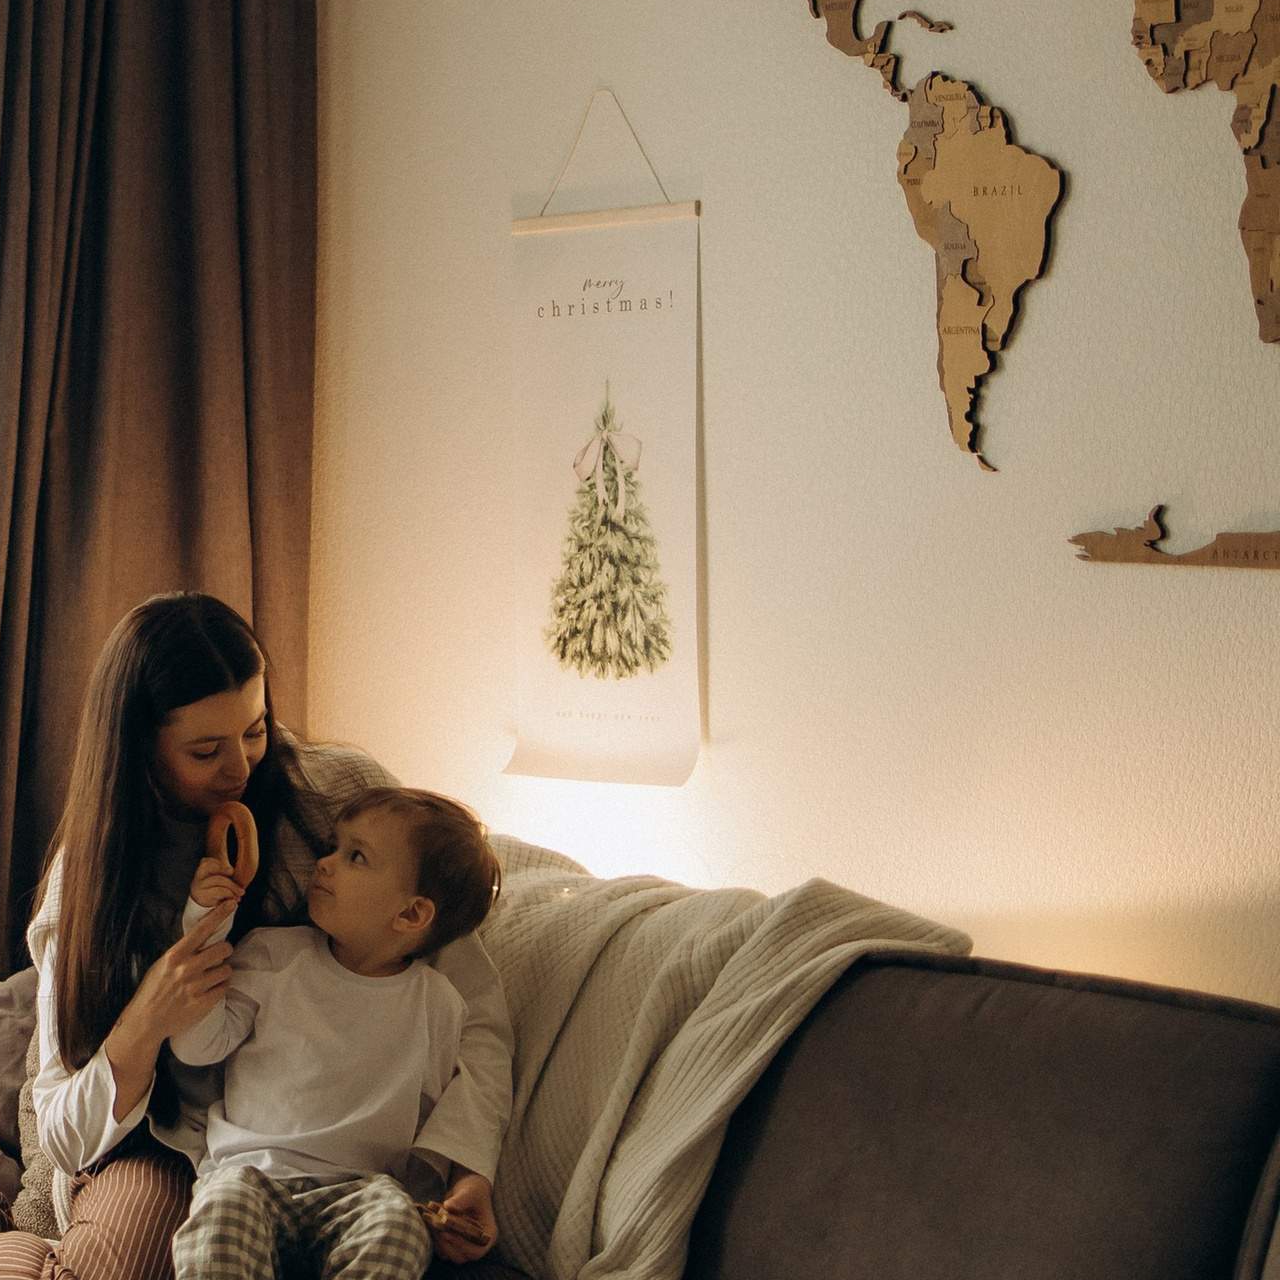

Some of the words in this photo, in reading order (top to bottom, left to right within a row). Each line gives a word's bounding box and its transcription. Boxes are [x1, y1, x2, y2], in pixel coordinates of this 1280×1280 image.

[973, 185, 1022, 196] BRAZIL
[582, 278, 625, 300] merry
[537, 289, 674, 318] christmas!
[942, 326, 980, 336] ARGENTINA
